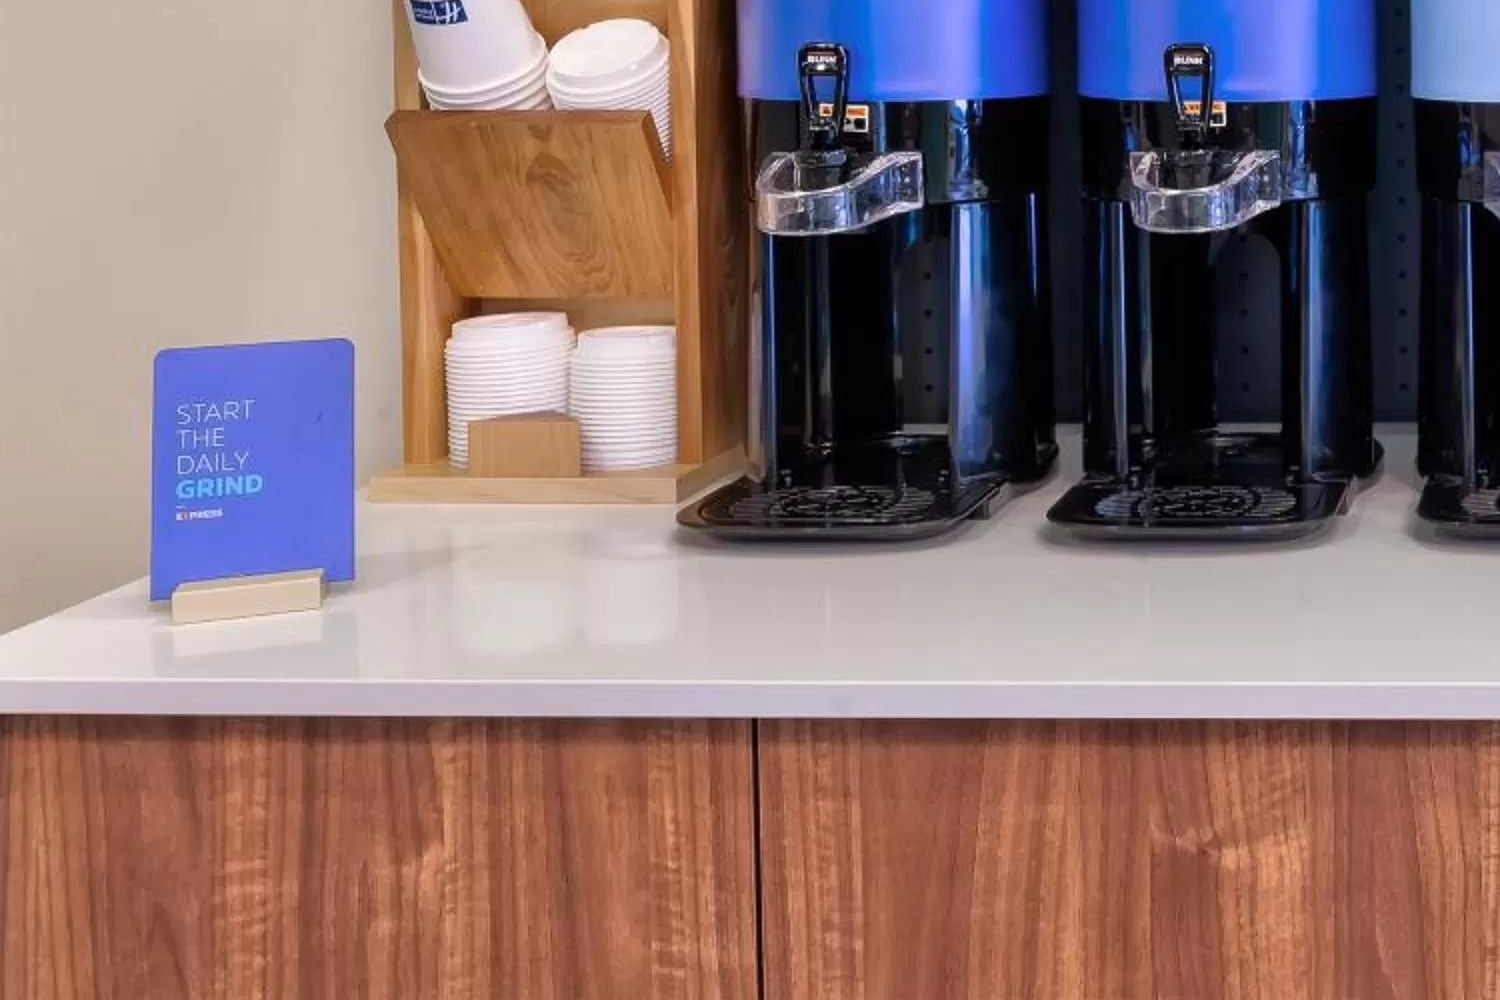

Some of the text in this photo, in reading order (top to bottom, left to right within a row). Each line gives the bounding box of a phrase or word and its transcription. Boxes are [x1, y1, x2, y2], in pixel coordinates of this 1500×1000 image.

[176, 399, 257, 426] START
[176, 427, 225, 450] THE
[177, 451, 250, 476] DAILY
[175, 474, 264, 500] GRIND
